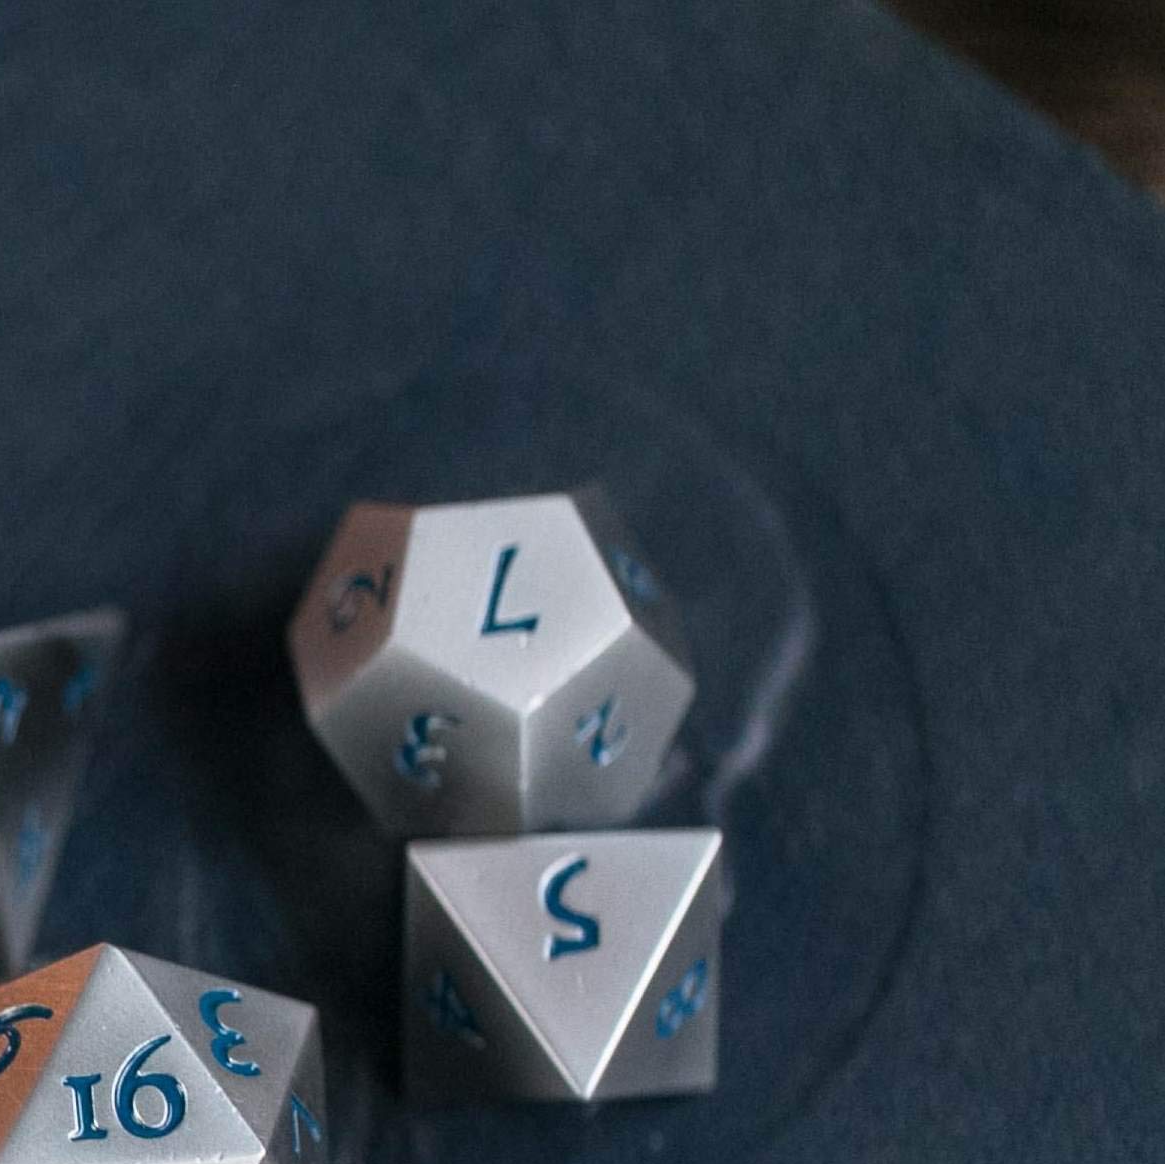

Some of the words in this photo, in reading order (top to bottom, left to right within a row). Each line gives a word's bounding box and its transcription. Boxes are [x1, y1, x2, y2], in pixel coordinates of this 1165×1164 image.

[481, 545, 540, 636] 7
[198, 988, 263, 1078] 3
[62, 1033, 189, 1141] 16
